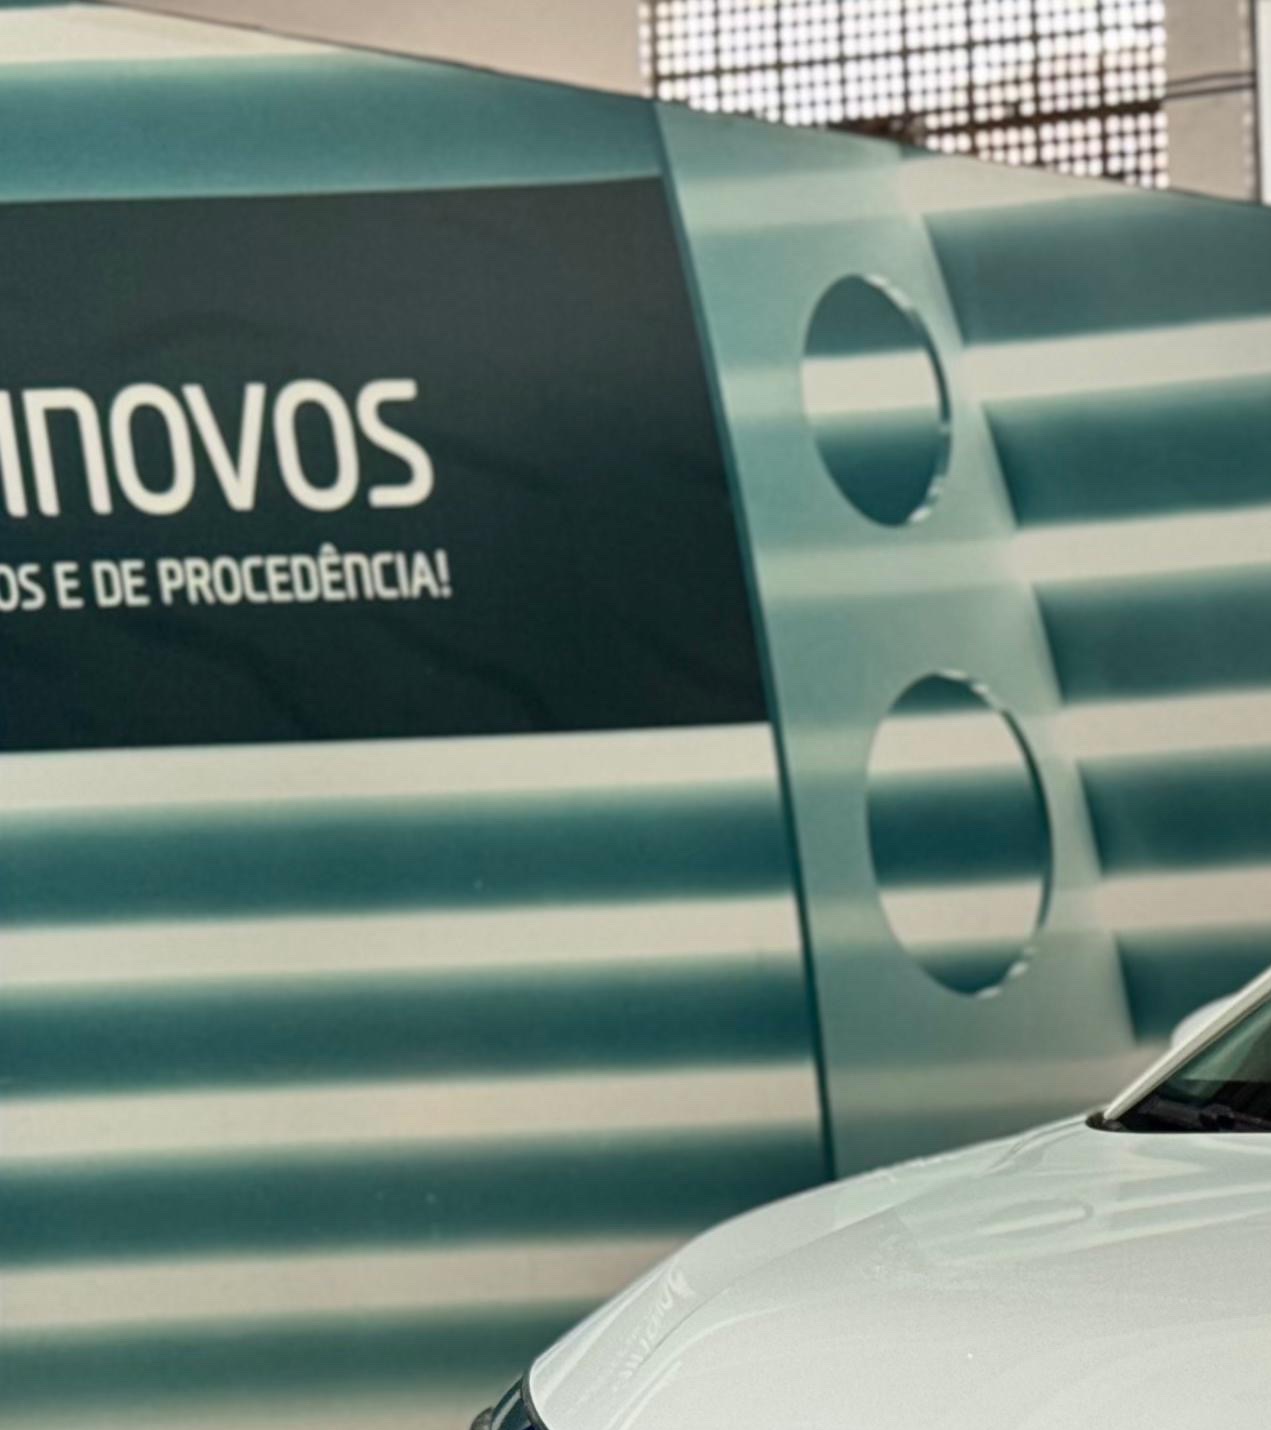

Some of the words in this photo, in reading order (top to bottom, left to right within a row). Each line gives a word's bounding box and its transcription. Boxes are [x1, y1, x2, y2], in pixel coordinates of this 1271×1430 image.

[53, 561, 84, 609] E
[92, 559, 150, 608] DE
[157, 542, 452, 605] PROCEDÊNCIA!
